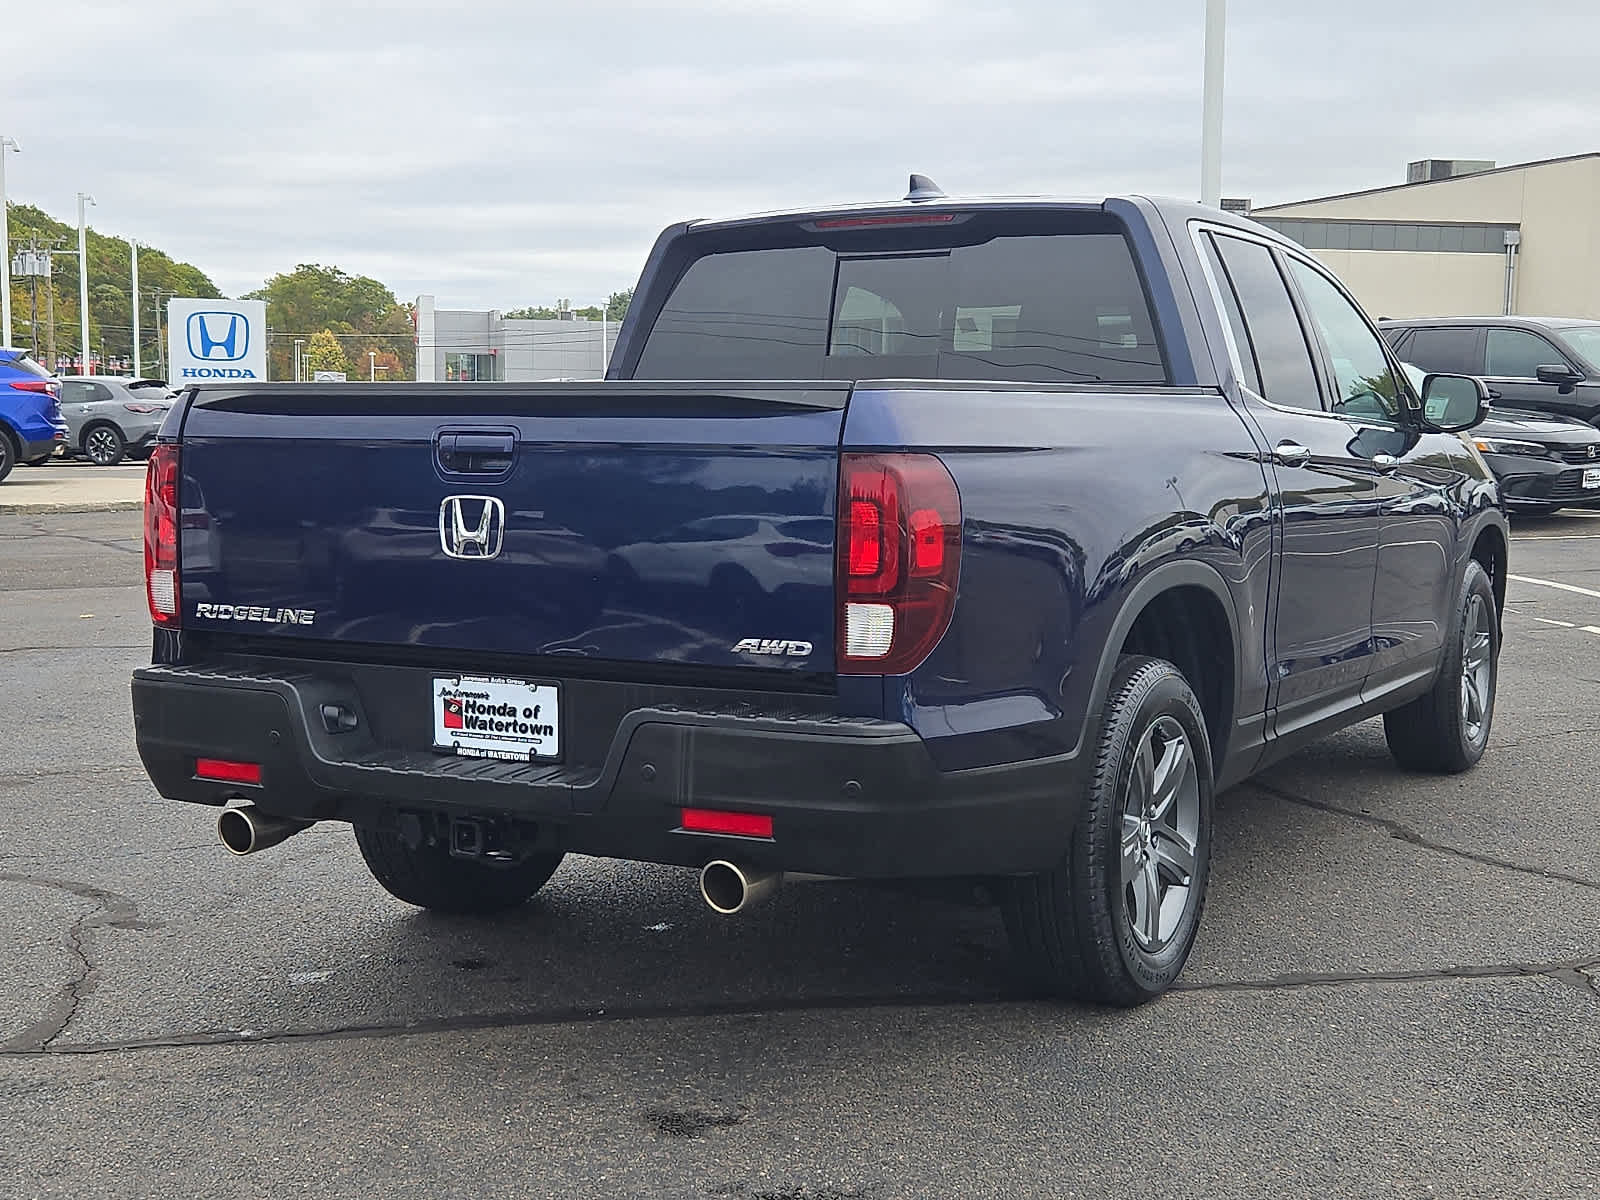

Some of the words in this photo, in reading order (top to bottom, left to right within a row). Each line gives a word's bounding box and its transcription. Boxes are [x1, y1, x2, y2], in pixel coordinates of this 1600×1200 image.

[182, 368, 257, 379] HONDA
[196, 602, 316, 625] RIDGELINE
[730, 638, 813, 656] AWD
[464, 699, 518, 718] Honda
[522, 704, 541, 720] of
[464, 715, 554, 737] Watertown
[456, 747, 481, 758] HONDA
[480, 750, 487, 758] of
[487, 750, 531, 762] WATERTOWN
